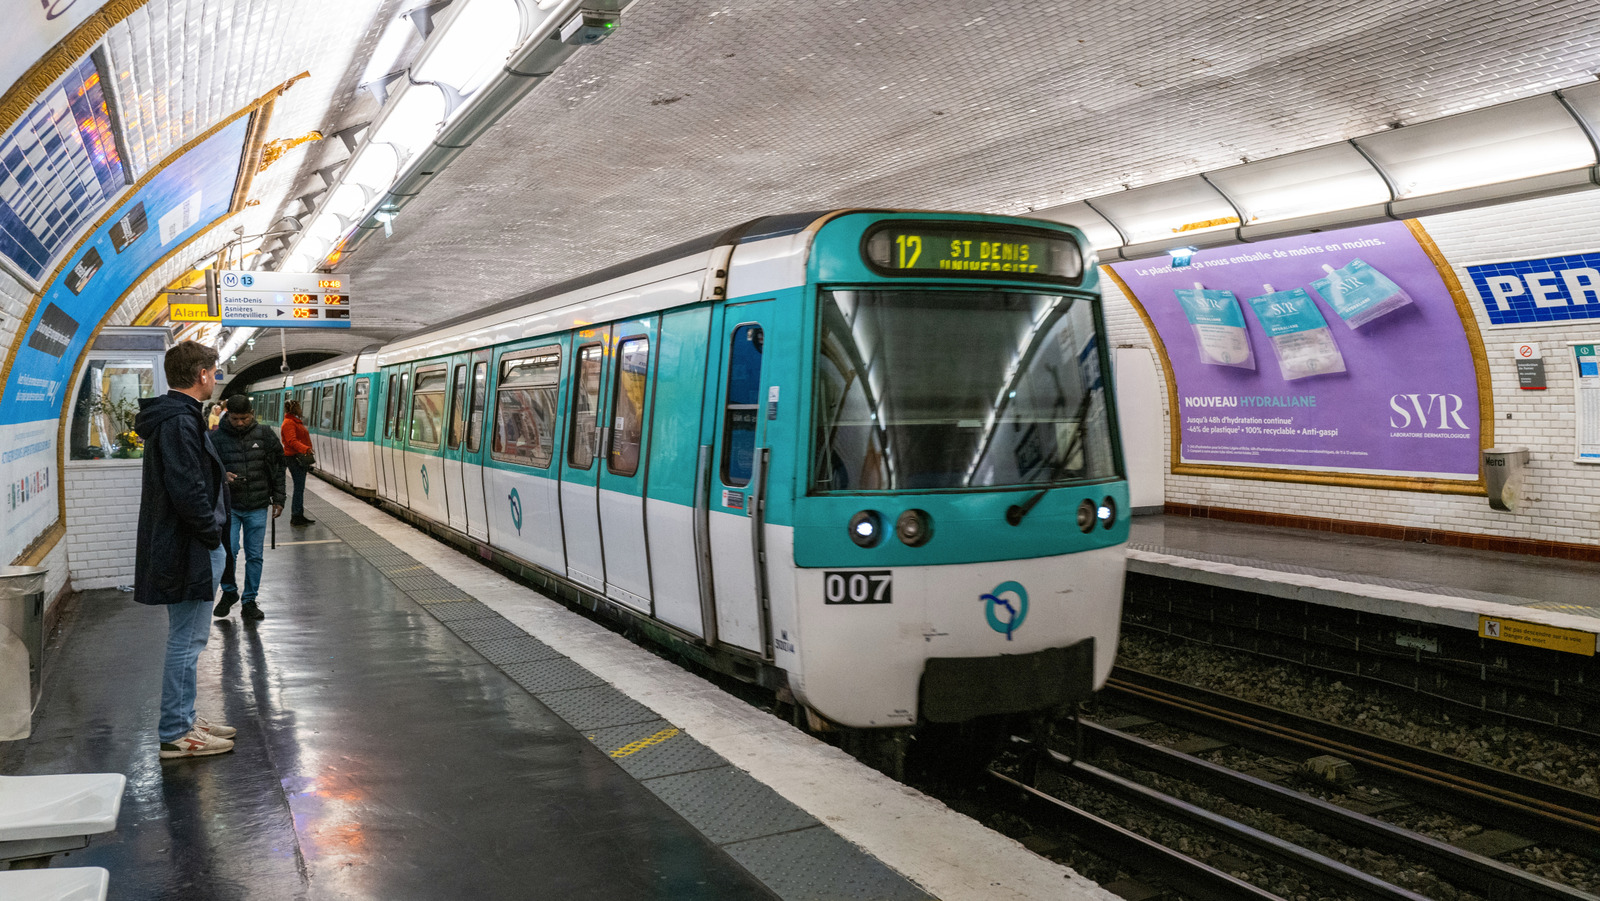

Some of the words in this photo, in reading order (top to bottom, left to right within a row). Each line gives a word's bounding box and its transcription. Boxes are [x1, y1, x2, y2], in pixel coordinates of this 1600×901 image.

[950, 240, 972, 258] ST
[980, 241, 1029, 261] DENIS
[1135, 268, 1148, 276] Le
[1192, 261, 1203, 271] ça
[1205, 258, 1230, 268] nous
[1230, 250, 1272, 264] emballe
[1272, 249, 1288, 258] de
[1288, 245, 1324, 257] moins
[1325, 243, 1341, 252] en
[1342, 238, 1386, 250] moins.
[241, 276, 253, 285] 13
[1485, 267, 1600, 311] PER
[293, 294, 309, 304] 00
[324, 294, 340, 305] 02
[174, 308, 208, 318] Alarm
[293, 307, 309, 318] 05
[1271, 302, 1297, 315] SVR
[1185, 397, 1237, 407] NOUVEAU
[1240, 396, 1317, 407] HYDRALIANE
[1390, 394, 1470, 430] SVR
[1187, 416, 1207, 424] Jusqu'à
[1209, 416, 1220, 424] 48h
[1221, 416, 1262, 425] d'hydratation
[1263, 427, 1295, 436] recyclable
[1302, 428, 1338, 437] Anti-gaspi
[1485, 457, 1505, 467] Merci
[826, 574, 893, 602] 007
[1503, 632, 1523, 640] Danger
[1524, 629, 1551, 638] descendre
